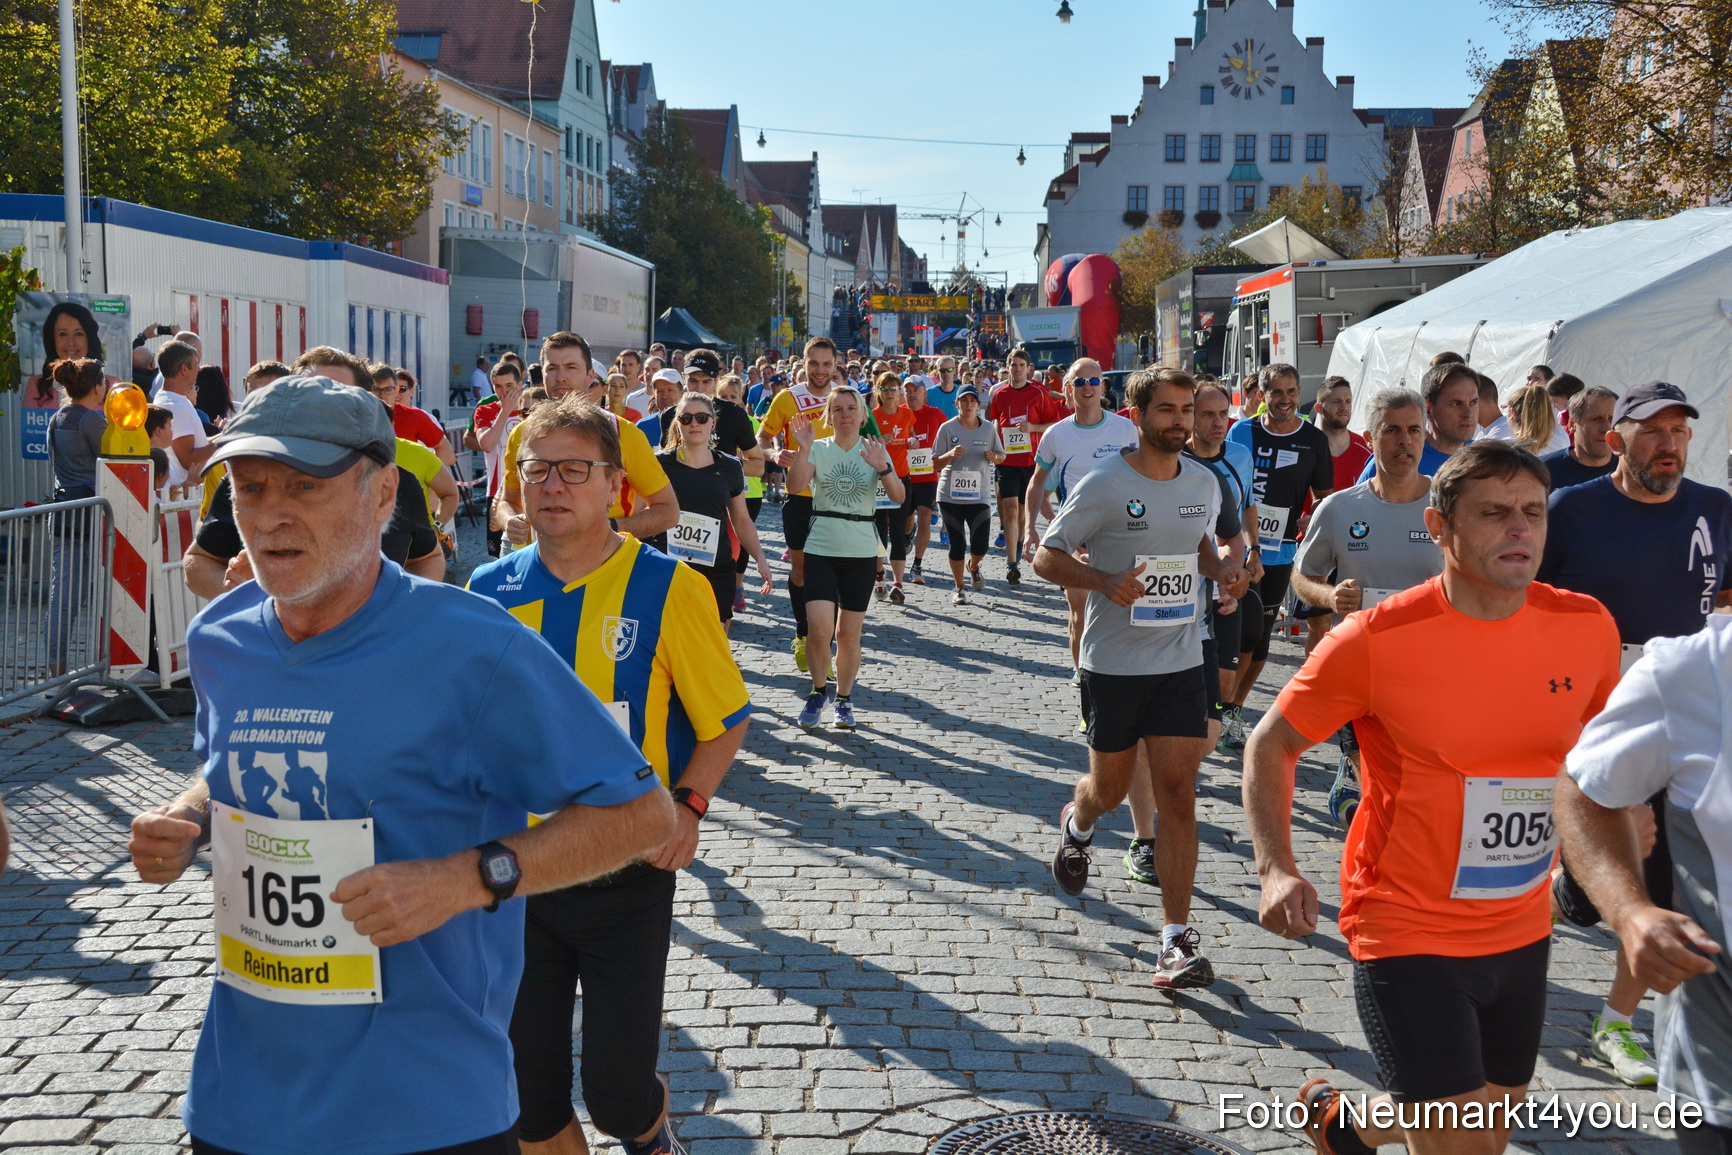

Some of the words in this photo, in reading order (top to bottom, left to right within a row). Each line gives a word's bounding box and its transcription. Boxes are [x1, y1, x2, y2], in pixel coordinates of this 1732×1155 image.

[903, 298, 936, 307] START
[1008, 433, 1024, 443] 272
[911, 455, 927, 465] 267
[955, 478, 977, 489] 2014
[1179, 504, 1207, 516] BOCK
[673, 524, 712, 544] 3047
[1156, 560, 1186, 570] BOCK
[496, 582, 523, 592] erima
[1145, 573, 1193, 597] 2630
[1700, 562, 1717, 615] ONE
[1155, 608, 1180, 619] Stefan
[233, 709, 249, 724] 20.
[252, 707, 334, 725] WALLENSTEIN
[228, 728, 326, 745] HALBMARATHON
[1501, 788, 1553, 801] BOCK
[1481, 811, 1555, 849] 3058
[245, 828, 313, 858] BOCK
[1485, 854, 1511, 862] PARTL
[241, 864, 325, 929] 165
[240, 924, 264, 942] PARTL
[265, 933, 318, 949] Neumarkt
[243, 949, 330, 984] Reinhard
